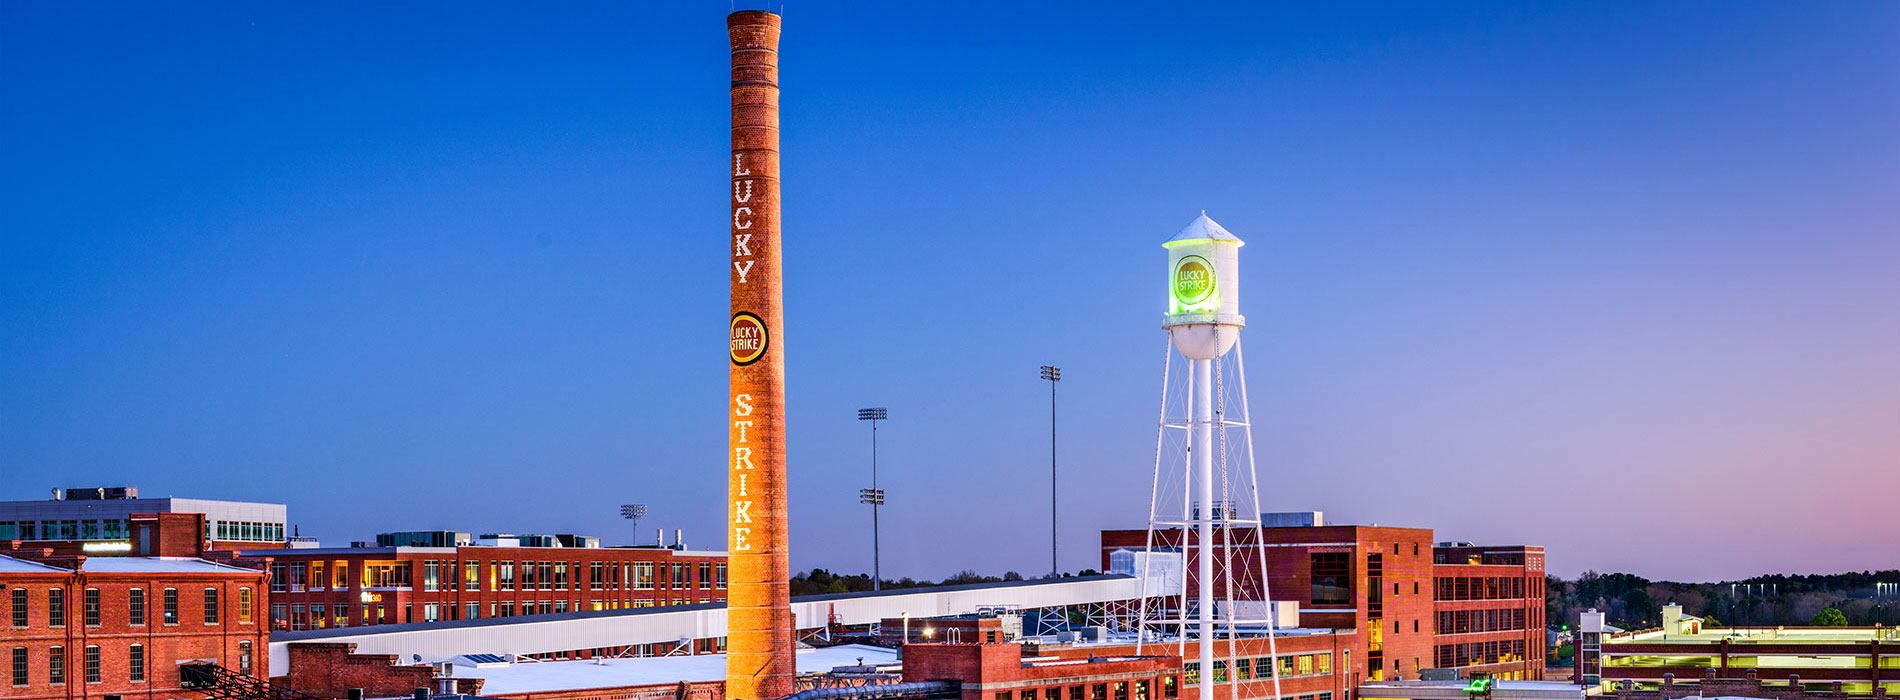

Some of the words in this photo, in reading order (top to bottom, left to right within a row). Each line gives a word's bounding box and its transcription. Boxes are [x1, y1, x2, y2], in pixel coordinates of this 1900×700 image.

[734, 153, 754, 283] LUCKY
[1180, 270, 1205, 281] LUCKY
[1179, 280, 1206, 291] STRIKE
[732, 326, 759, 339] LUCKY
[731, 338, 759, 351] STRIKE
[734, 393, 754, 551] STRIKE
